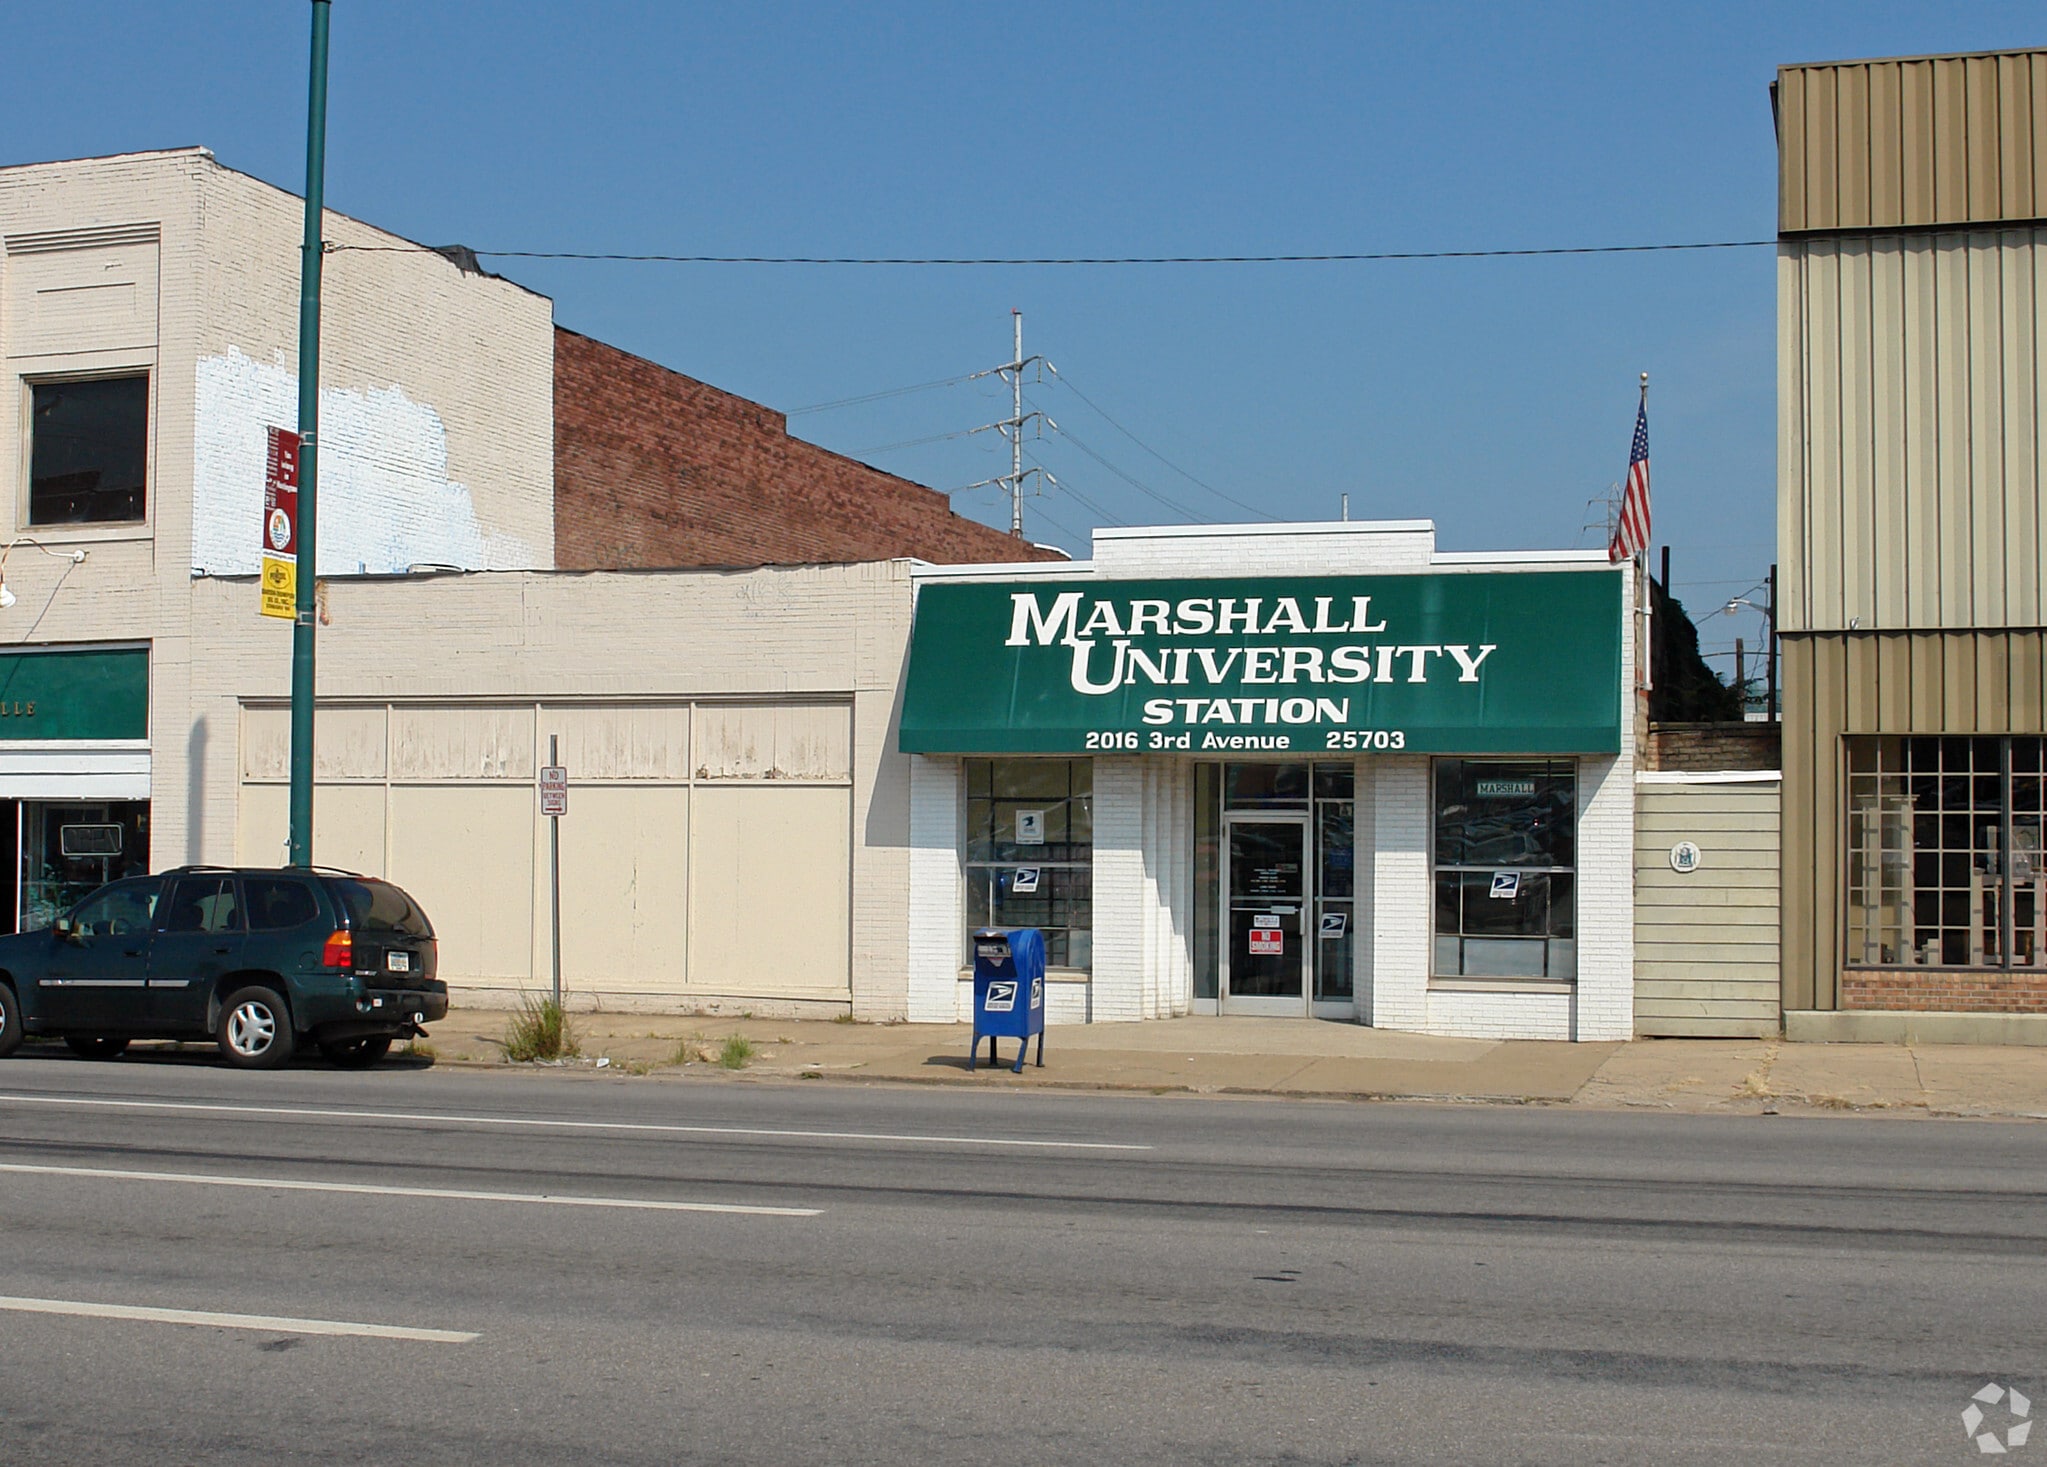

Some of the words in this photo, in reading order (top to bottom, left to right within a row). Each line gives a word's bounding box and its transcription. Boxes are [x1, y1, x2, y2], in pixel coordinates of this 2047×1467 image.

[1005, 592, 1387, 646] MARSHALL
[1070, 639, 1496, 695] UNIVERSITY
[1142, 698, 1349, 724] STATION
[1085, 732, 1138, 749] 2016
[1148, 732, 1191, 749] 3rd
[1201, 732, 1290, 749] Avenue
[1326, 731, 1405, 749] 25703
[549, 771, 559, 780] NO
[541, 782, 564, 790] PARKING
[1479, 783, 1534, 794] MARSHALL
[1251, 941, 1280, 950] SMOKING
